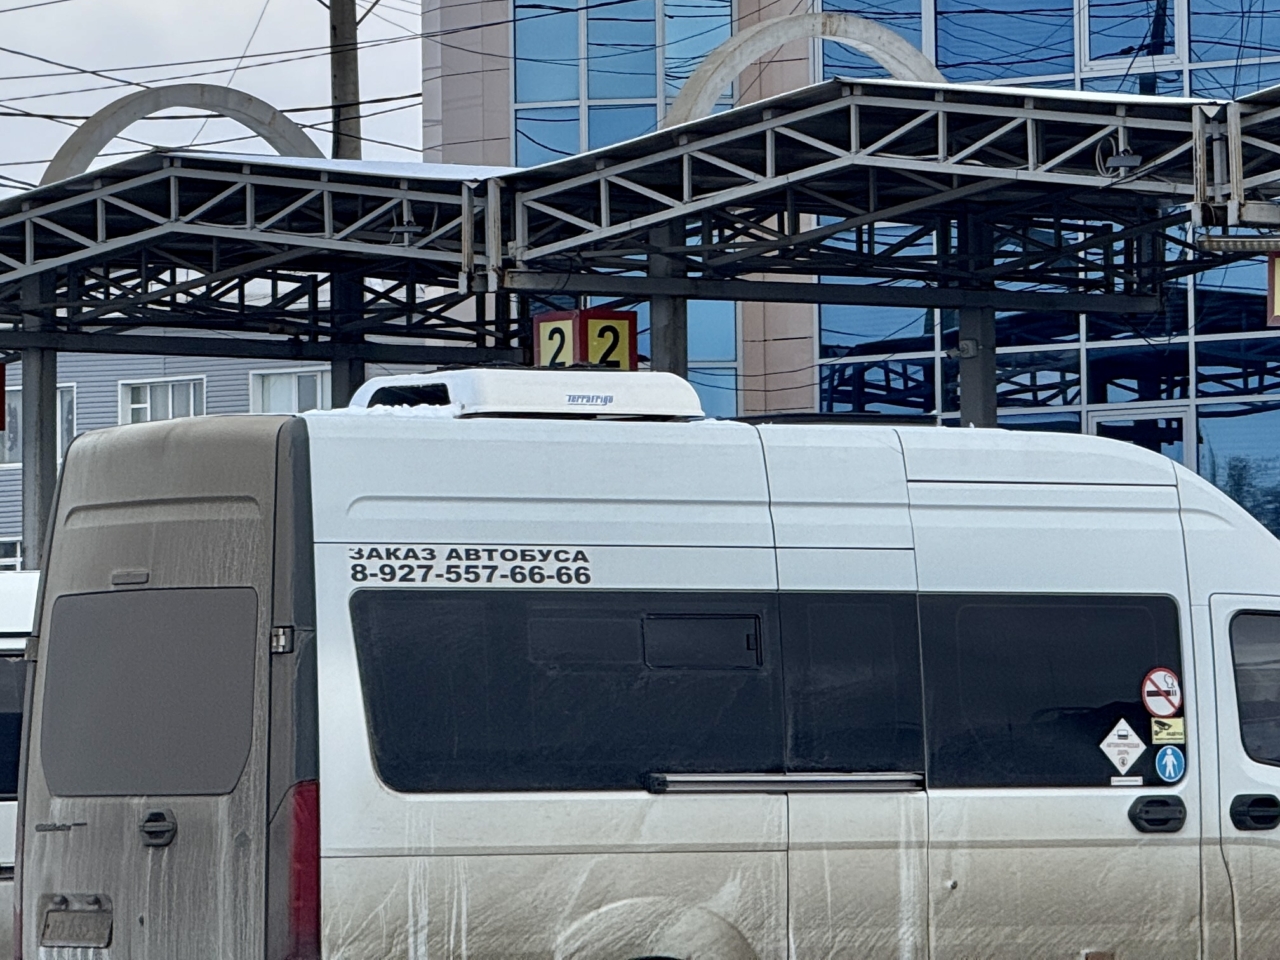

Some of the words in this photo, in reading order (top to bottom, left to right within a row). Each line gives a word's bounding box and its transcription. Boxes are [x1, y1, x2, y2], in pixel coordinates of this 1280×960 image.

[548, 326, 566, 367] 2
[597, 325, 620, 368] 2
[349, 547, 437, 561] ЗАКАЗ
[445, 548, 590, 563] АВТОБУСА
[350, 563, 592, 585] 8-927-557-66-66
